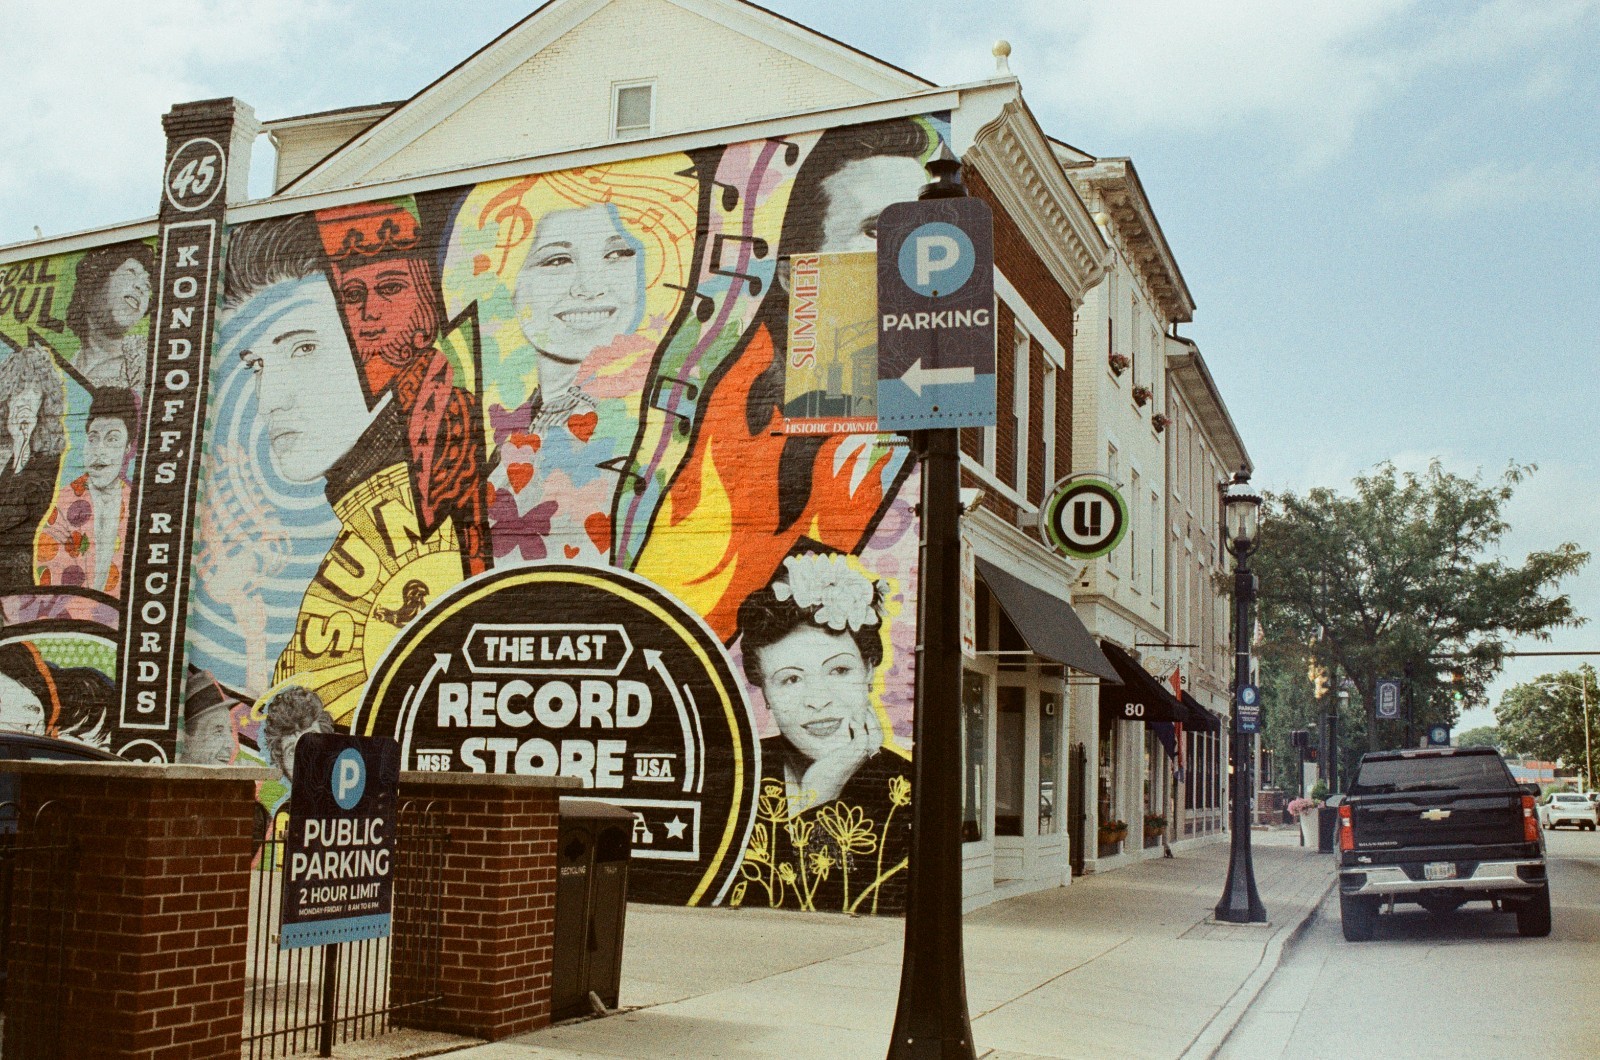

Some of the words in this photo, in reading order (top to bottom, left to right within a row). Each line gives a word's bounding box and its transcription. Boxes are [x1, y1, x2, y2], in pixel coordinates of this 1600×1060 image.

[172, 155, 217, 198] 45
[916, 235, 960, 286] P
[792, 256, 819, 369] SUMMER
[882, 308, 989, 332] PARKING
[785, 422, 829, 434] HISTORIC
[137, 512, 172, 714] RECORDS
[484, 636, 535, 662] THE
[541, 635, 607, 662] LAST
[437, 679, 653, 729] RECORD
[1125, 703, 1144, 717] 80
[417, 754, 451, 772] MSB
[460, 737, 627, 789] STORE
[635, 758, 672, 778] USA
[338, 759, 360, 800] P
[303, 817, 385, 848] PUBLIC
[291, 848, 390, 882] PARKING
[299, 887, 308, 905] 2
[310, 885, 348, 904] HOUR
[350, 882, 381, 900] LIMIT
